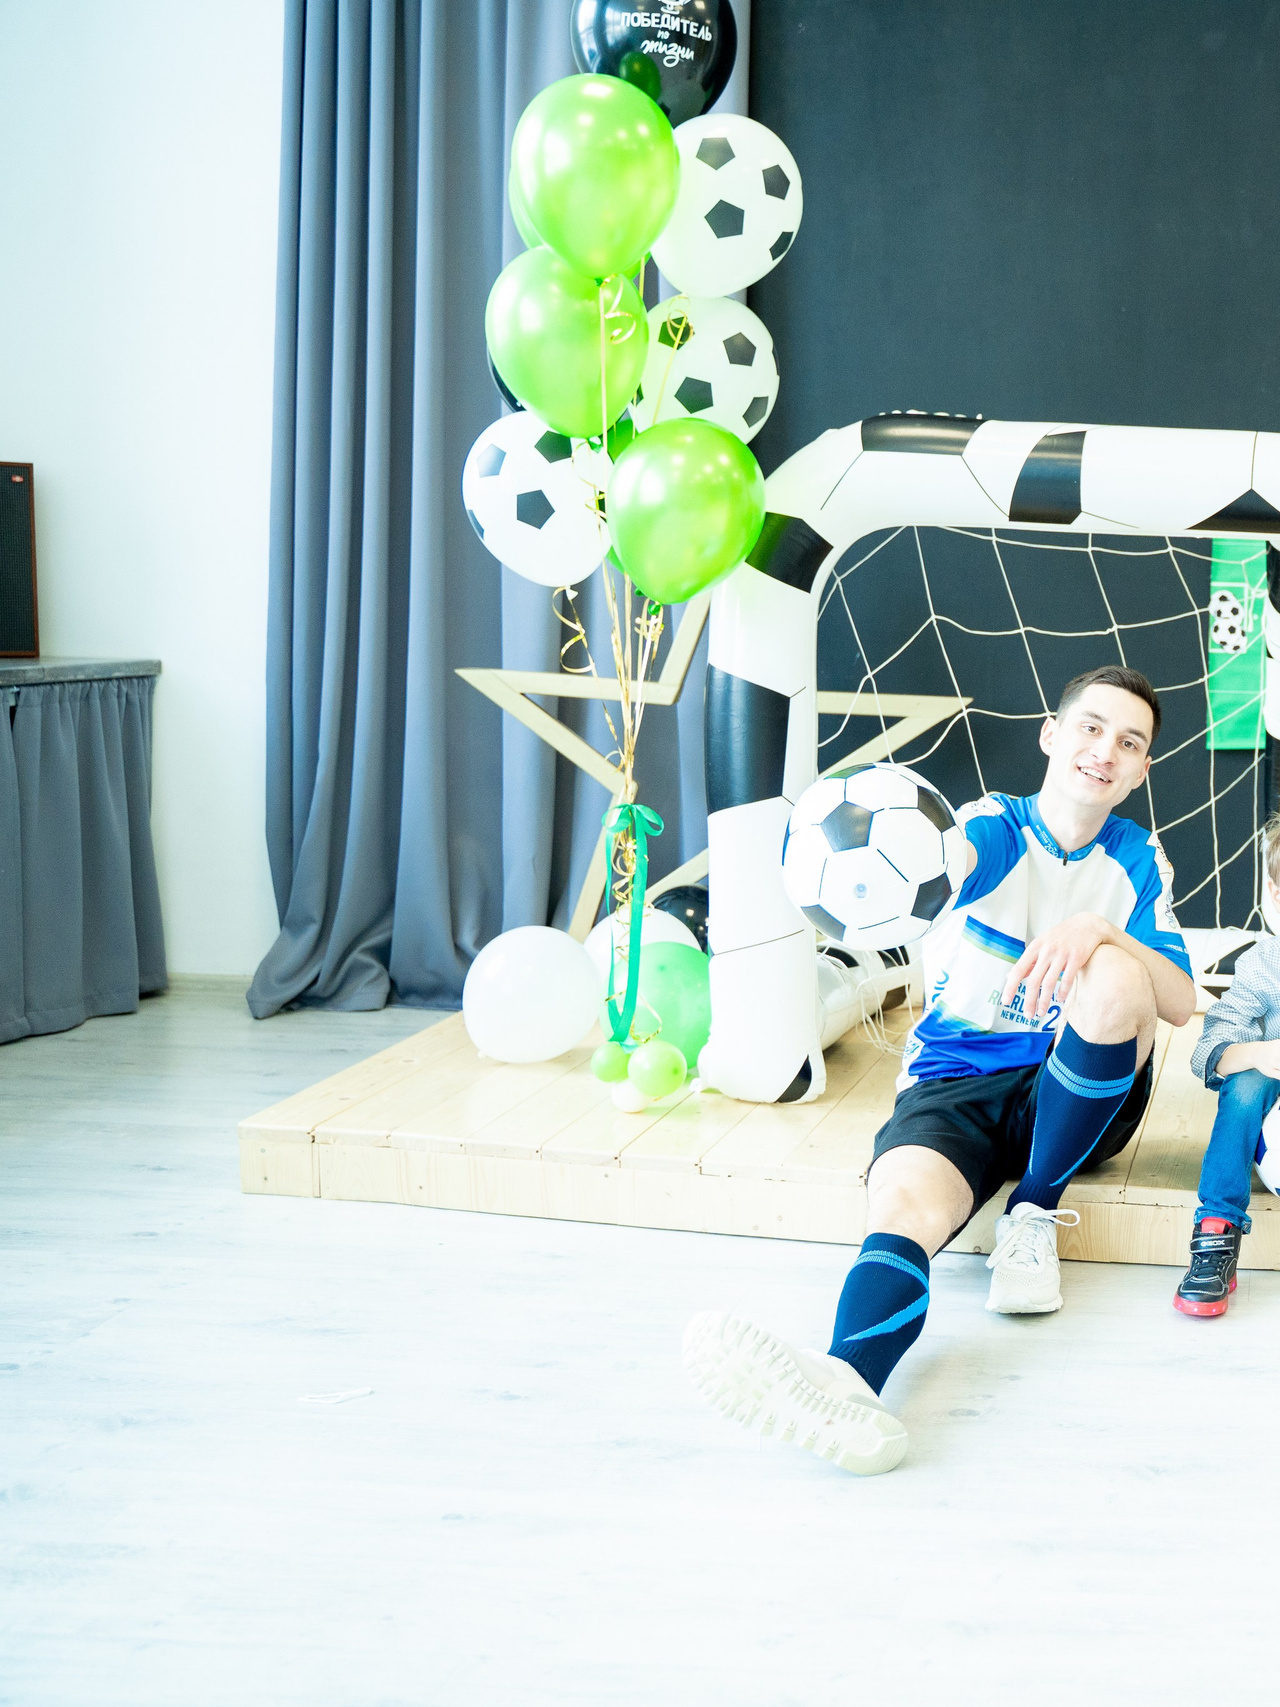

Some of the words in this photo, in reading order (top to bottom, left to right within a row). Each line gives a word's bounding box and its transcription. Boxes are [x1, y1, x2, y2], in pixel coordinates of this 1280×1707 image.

[620, 12, 713, 42] ПОБЕДИТЕЛЬ
[656, 29, 671, 40] по
[639, 39, 695, 68] жизни
[1000, 1009, 1016, 1020] NEW
